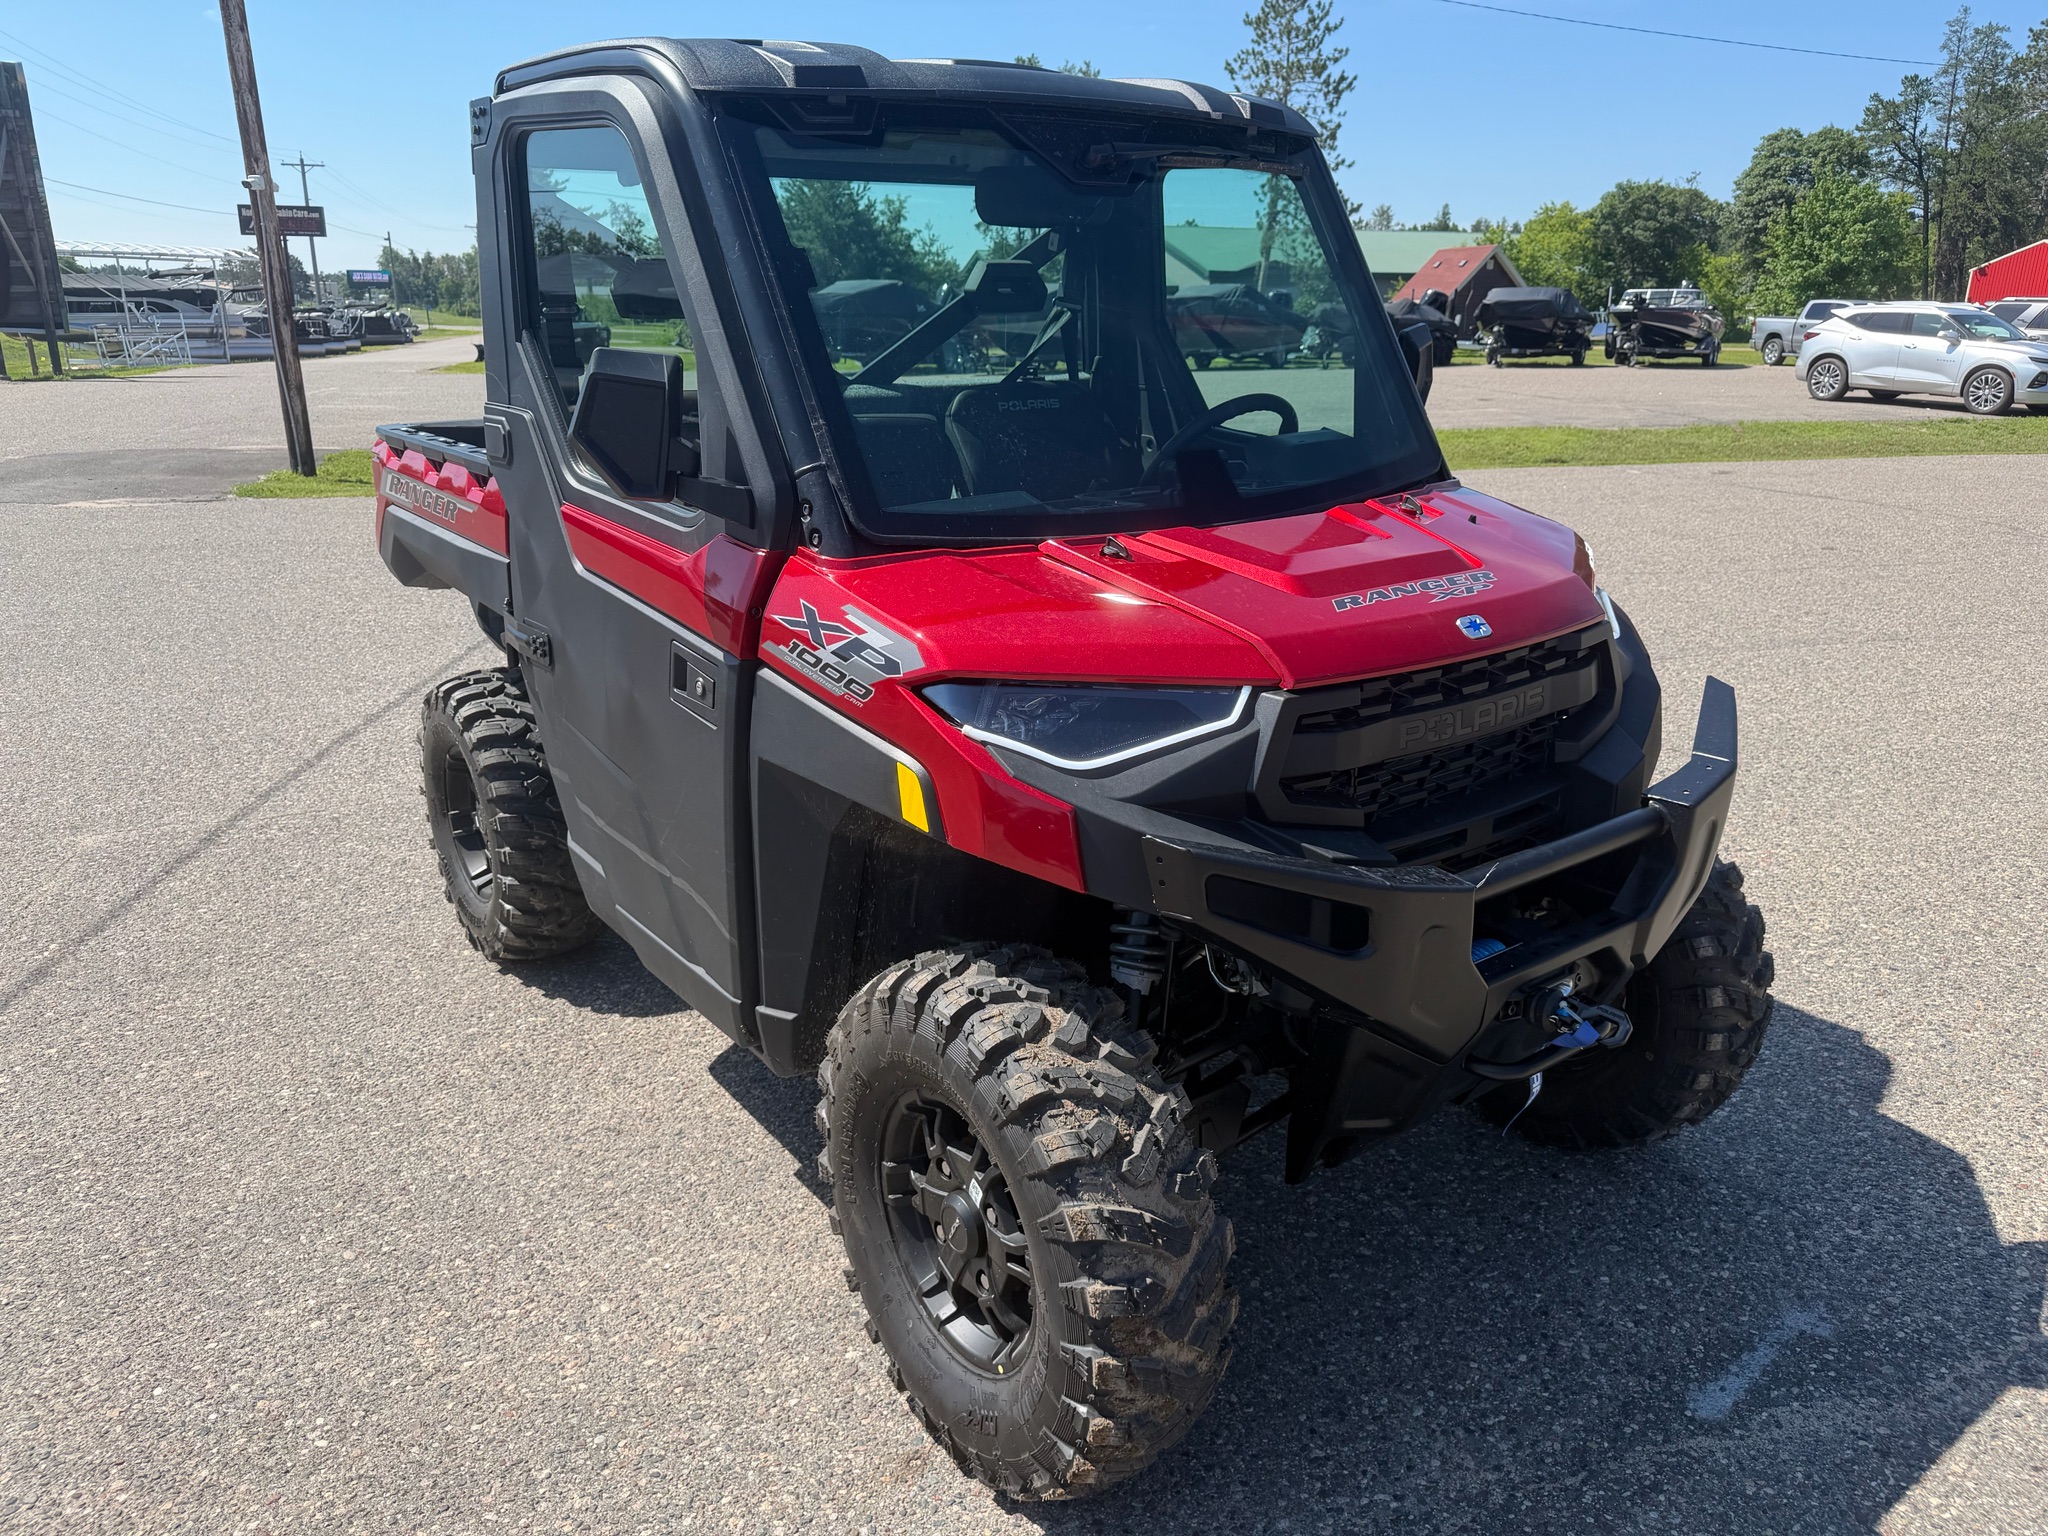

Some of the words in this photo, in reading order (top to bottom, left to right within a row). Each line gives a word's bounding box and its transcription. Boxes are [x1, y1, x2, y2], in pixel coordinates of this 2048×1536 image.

[997, 398, 1060, 413] POLARIS
[389, 473, 459, 523] RANGER
[1331, 570, 1498, 613] RANGER
[1428, 583, 1494, 604] XP
[770, 598, 904, 678] XP
[784, 655, 802, 670] DUAL
[803, 667, 845, 696] OVERHEAD
[844, 693, 864, 709] CAM
[786, 638, 875, 703] 1000
[1400, 685, 1545, 749] POLARIS
